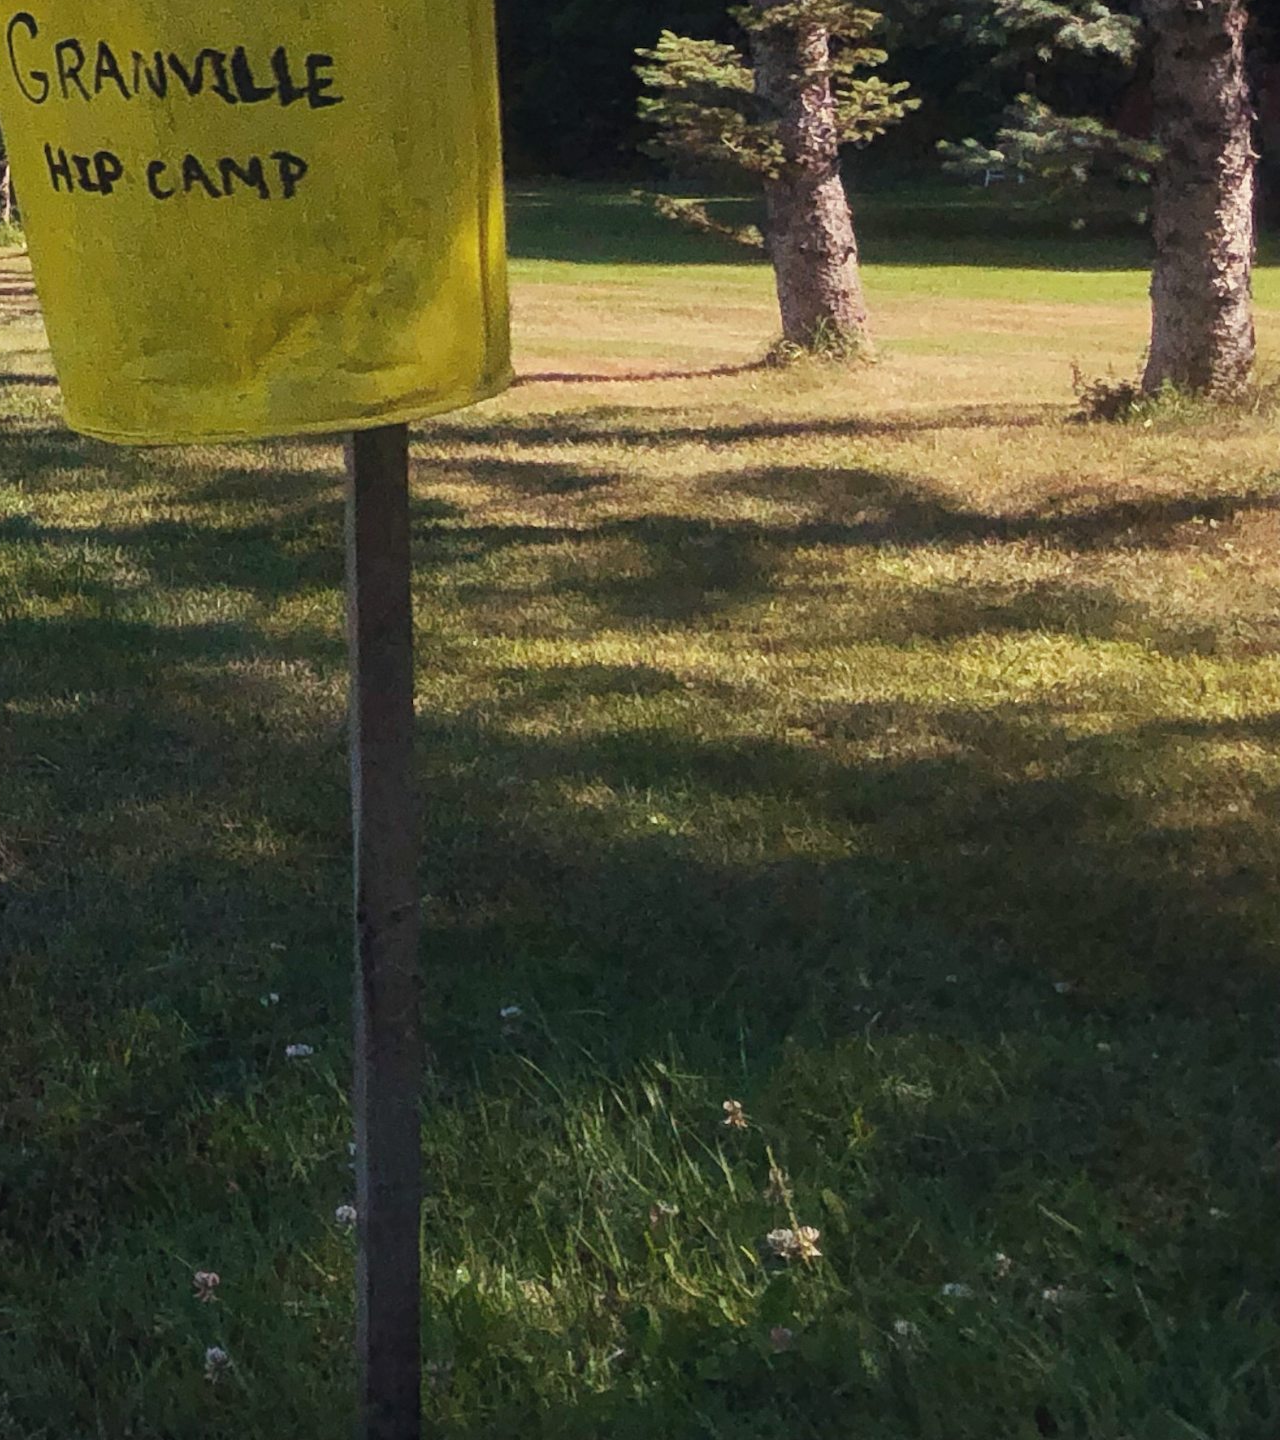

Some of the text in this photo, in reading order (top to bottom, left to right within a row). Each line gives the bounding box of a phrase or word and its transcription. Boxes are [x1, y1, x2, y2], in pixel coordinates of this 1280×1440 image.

[6, 12, 344, 109] GRANVILLE
[44, 142, 309, 200] HIP CAMP
